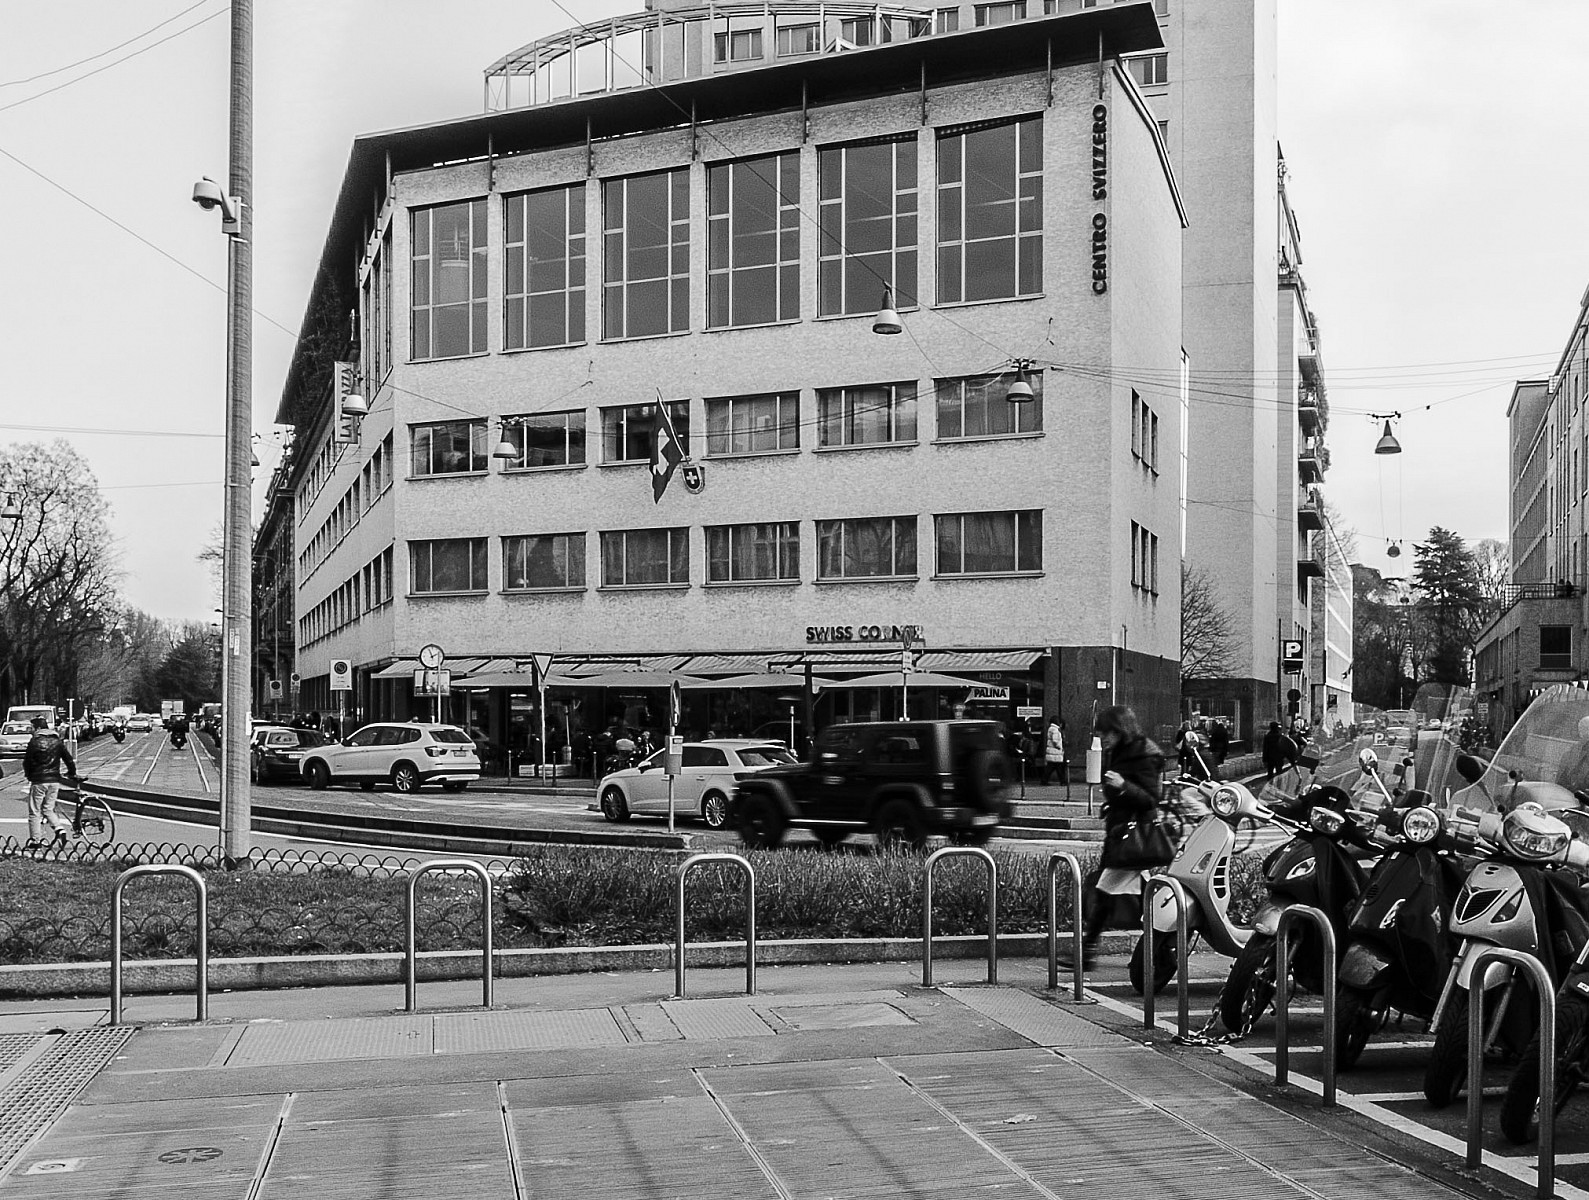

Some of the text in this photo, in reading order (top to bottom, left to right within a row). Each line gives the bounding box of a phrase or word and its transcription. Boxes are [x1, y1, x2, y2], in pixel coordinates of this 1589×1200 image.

[1092, 103, 1107, 295] CENTRO SVIZZERO
[806, 625, 853, 641] SWISS
[1286, 641, 1301, 658] P
[979, 672, 1002, 680] HELLO
